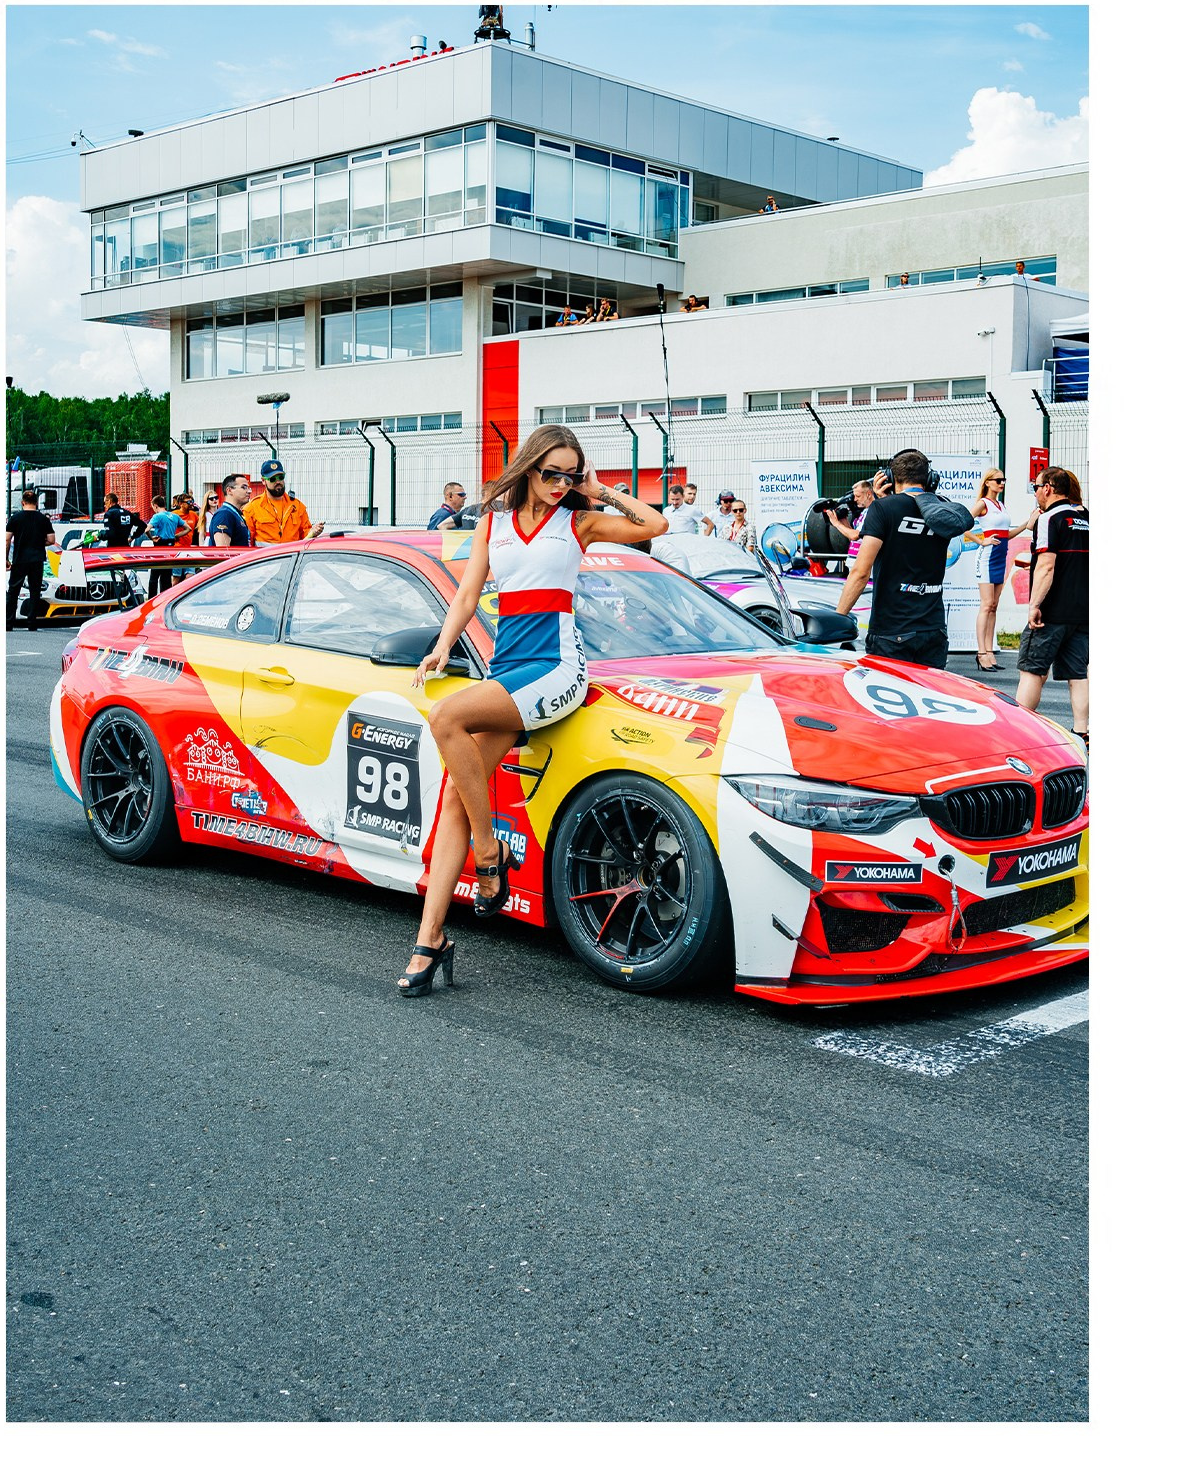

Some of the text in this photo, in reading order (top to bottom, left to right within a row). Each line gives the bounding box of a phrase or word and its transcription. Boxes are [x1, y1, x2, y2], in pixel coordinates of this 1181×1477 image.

[759, 473, 810, 483] ФУРАЦИЛИН
[935, 470, 982, 480] АЦИЛИН
[760, 484, 804, 493] АВЕКСИМА
[938, 481, 974, 491] КСИМА
[550, 684, 578, 712] SMP
[630, 728, 651, 738] ACTION
[187, 767, 241, 790] БАНИ.РФ
[356, 755, 409, 811] 98
[360, 812, 420, 840] SMP RACING
[1018, 842, 1078, 876] YOKOHAMA
[854, 866, 916, 879] YOKOHAMA
